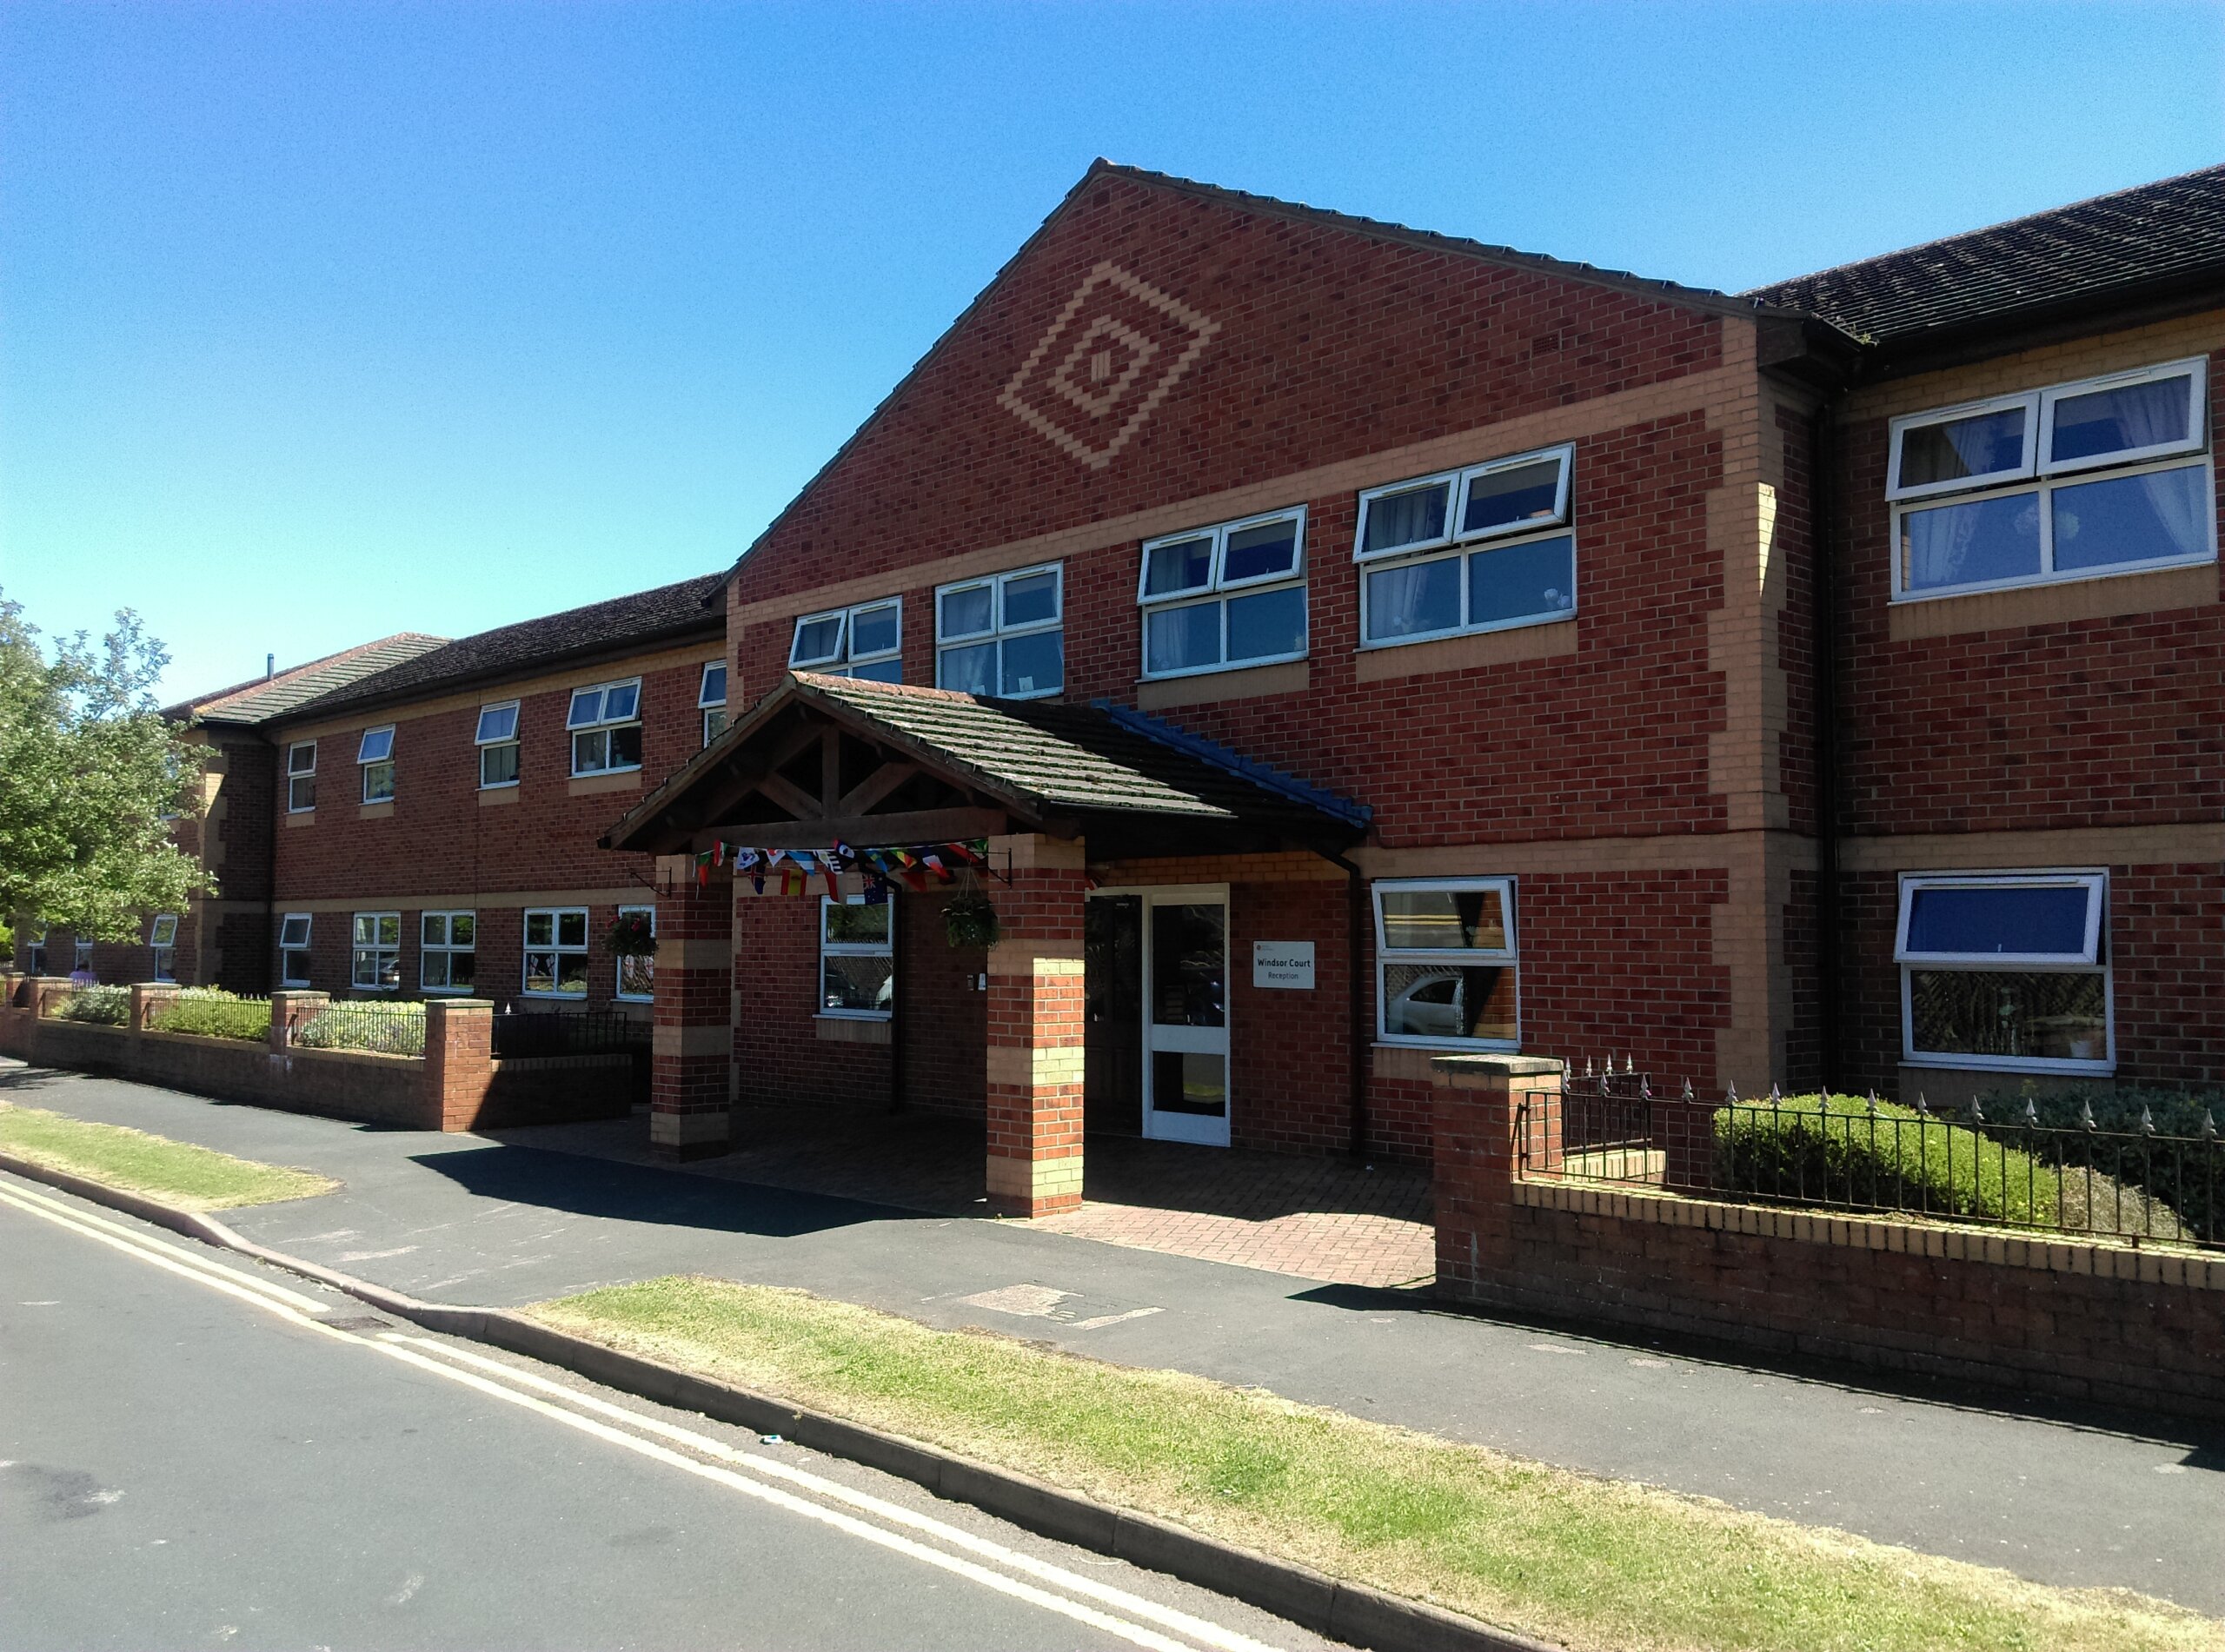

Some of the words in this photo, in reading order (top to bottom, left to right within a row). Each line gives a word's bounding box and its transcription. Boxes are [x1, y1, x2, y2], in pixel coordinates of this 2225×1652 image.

[1258, 958, 1287, 967] Windsor
[1289, 959, 1311, 967] Court
[1268, 972, 1298, 980] Reception
